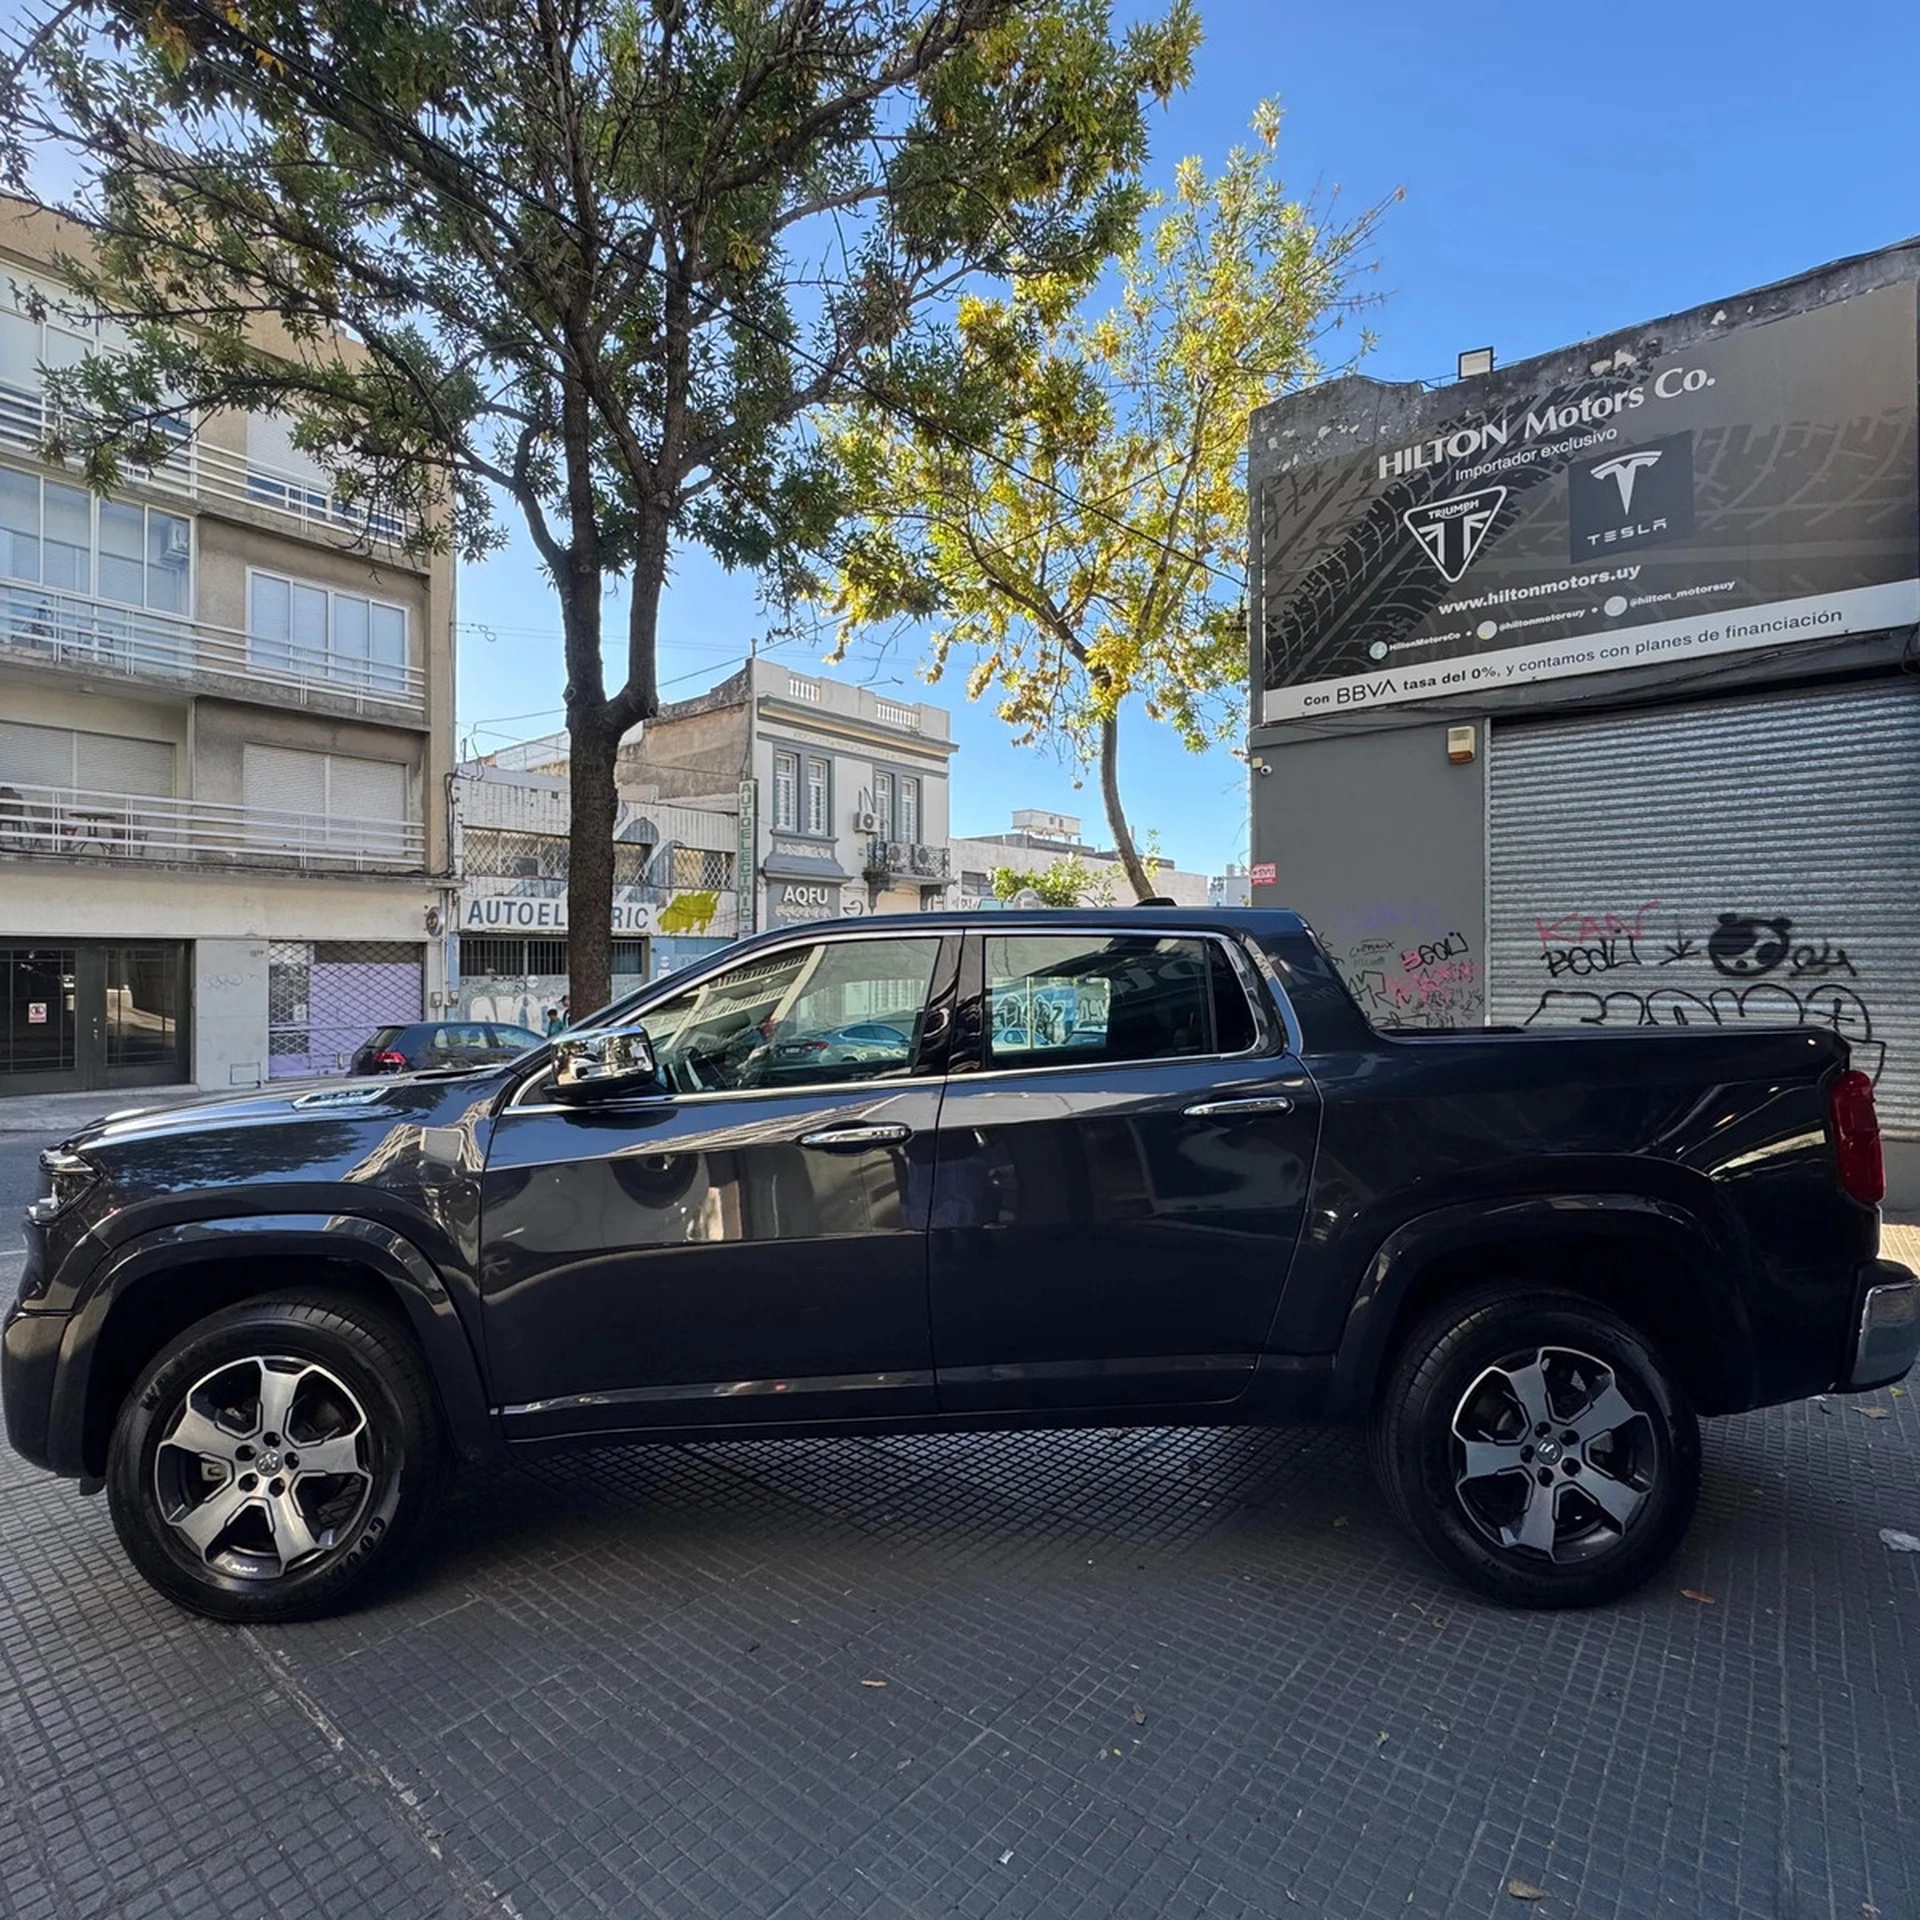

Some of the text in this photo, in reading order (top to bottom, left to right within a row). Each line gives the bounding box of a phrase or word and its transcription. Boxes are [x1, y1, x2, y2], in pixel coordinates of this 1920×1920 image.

[1378, 367, 1716, 480] HILTON Motors Co.
[1455, 427, 1618, 482] Importador exclusivo
[1427, 499, 1480, 520] TRIUMPH
[1586, 517, 1668, 547] TESLA
[1437, 564, 1642, 616] www.hiltonmotors.uy
[1629, 580, 1736, 608] @hilton_motorsuy
[1303, 610, 1843, 706] Con BBVA tasa del 0%, y contamos con planes de financiación
[783, 885, 829, 906] AQFU
[467, 900, 649, 929] AUTOELRIC
